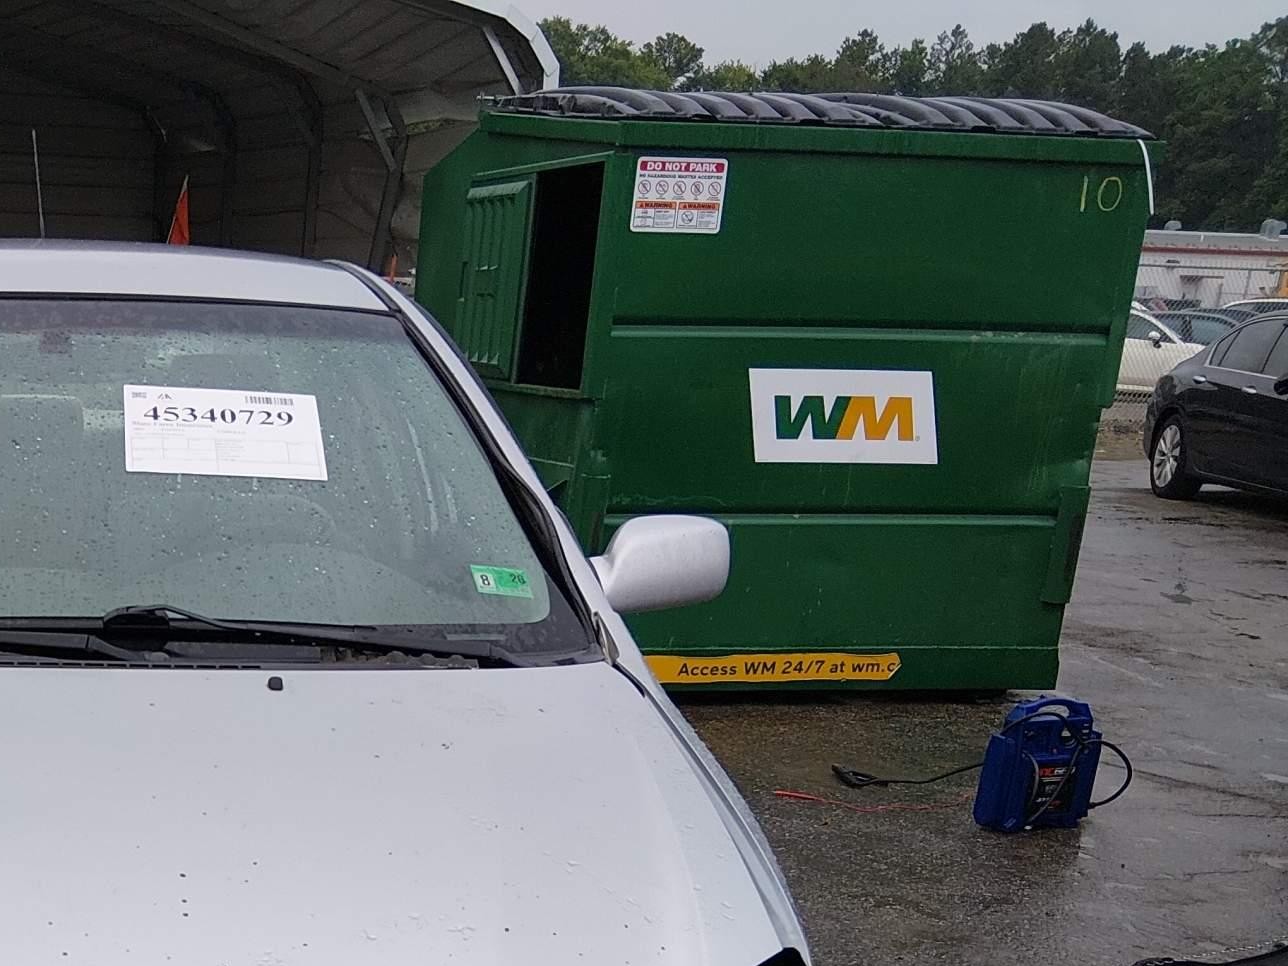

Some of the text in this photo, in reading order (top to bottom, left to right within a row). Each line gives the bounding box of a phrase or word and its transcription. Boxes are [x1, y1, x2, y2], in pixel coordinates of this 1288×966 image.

[647, 161, 718, 173] DO NOT PARK
[1079, 175, 1123, 212] 10
[143, 405, 294, 427] 45340729
[774, 395, 914, 441] WM
[480, 574, 490, 586] 8
[677, 662, 737, 677] Access
[744, 661, 777, 676] WM
[781, 660, 825, 675] 24/7
[829, 661, 846, 673] at
